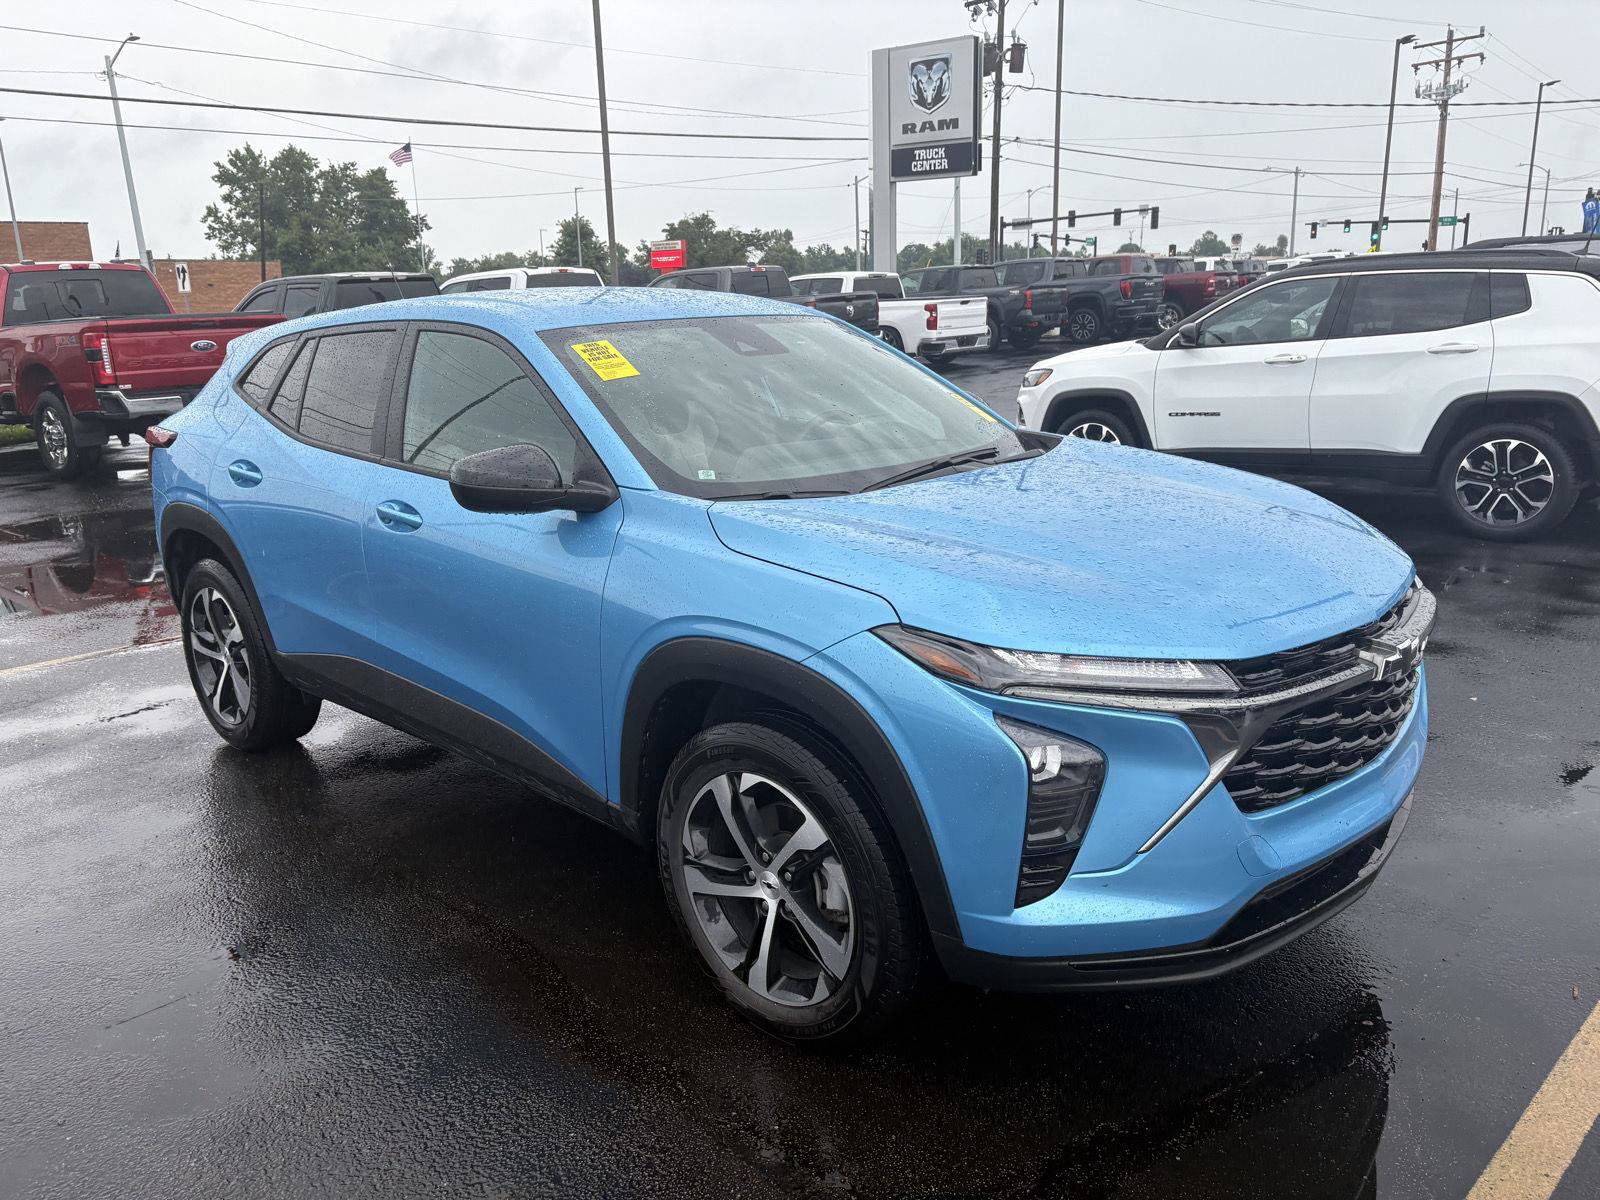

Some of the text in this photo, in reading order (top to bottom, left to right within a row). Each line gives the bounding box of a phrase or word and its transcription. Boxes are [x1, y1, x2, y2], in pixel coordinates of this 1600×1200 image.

[902, 118, 959, 135] RAM
[914, 147, 945, 160] TRUCK
[911, 159, 948, 172] CENTER
